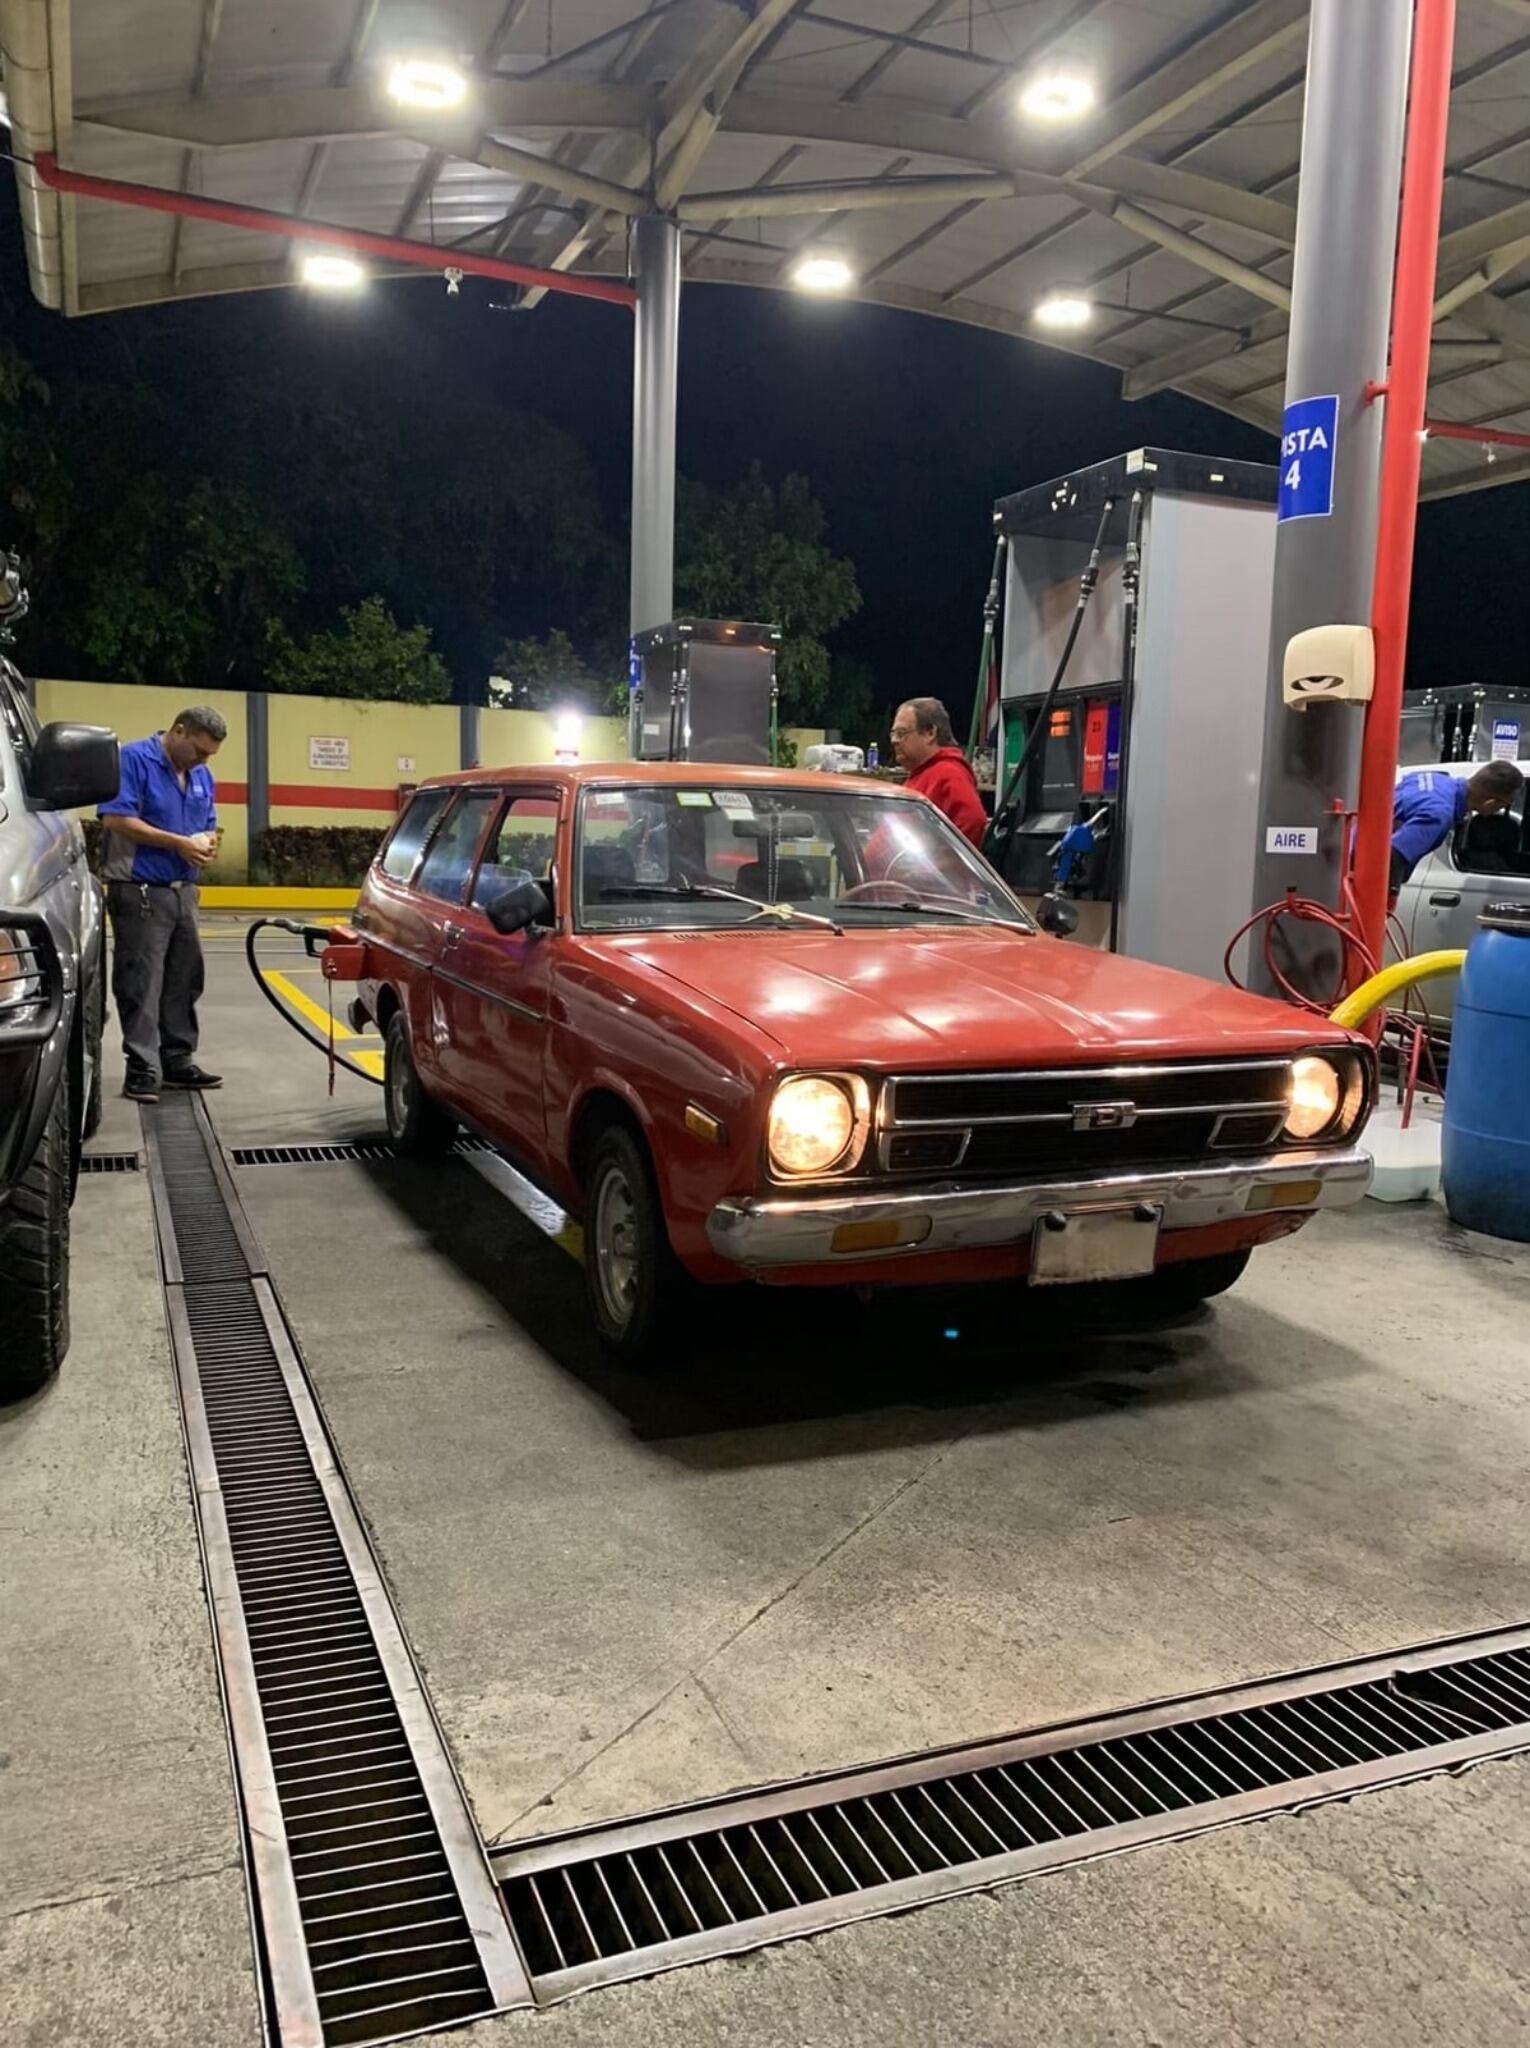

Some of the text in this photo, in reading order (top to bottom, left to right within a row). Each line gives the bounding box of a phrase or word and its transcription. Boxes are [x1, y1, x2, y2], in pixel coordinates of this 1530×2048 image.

[1281, 426, 1328, 458] ISTA
[1284, 459, 1301, 491] 4
[1495, 724, 1518, 737] AVISO
[1274, 832, 1307, 848] AIRE
